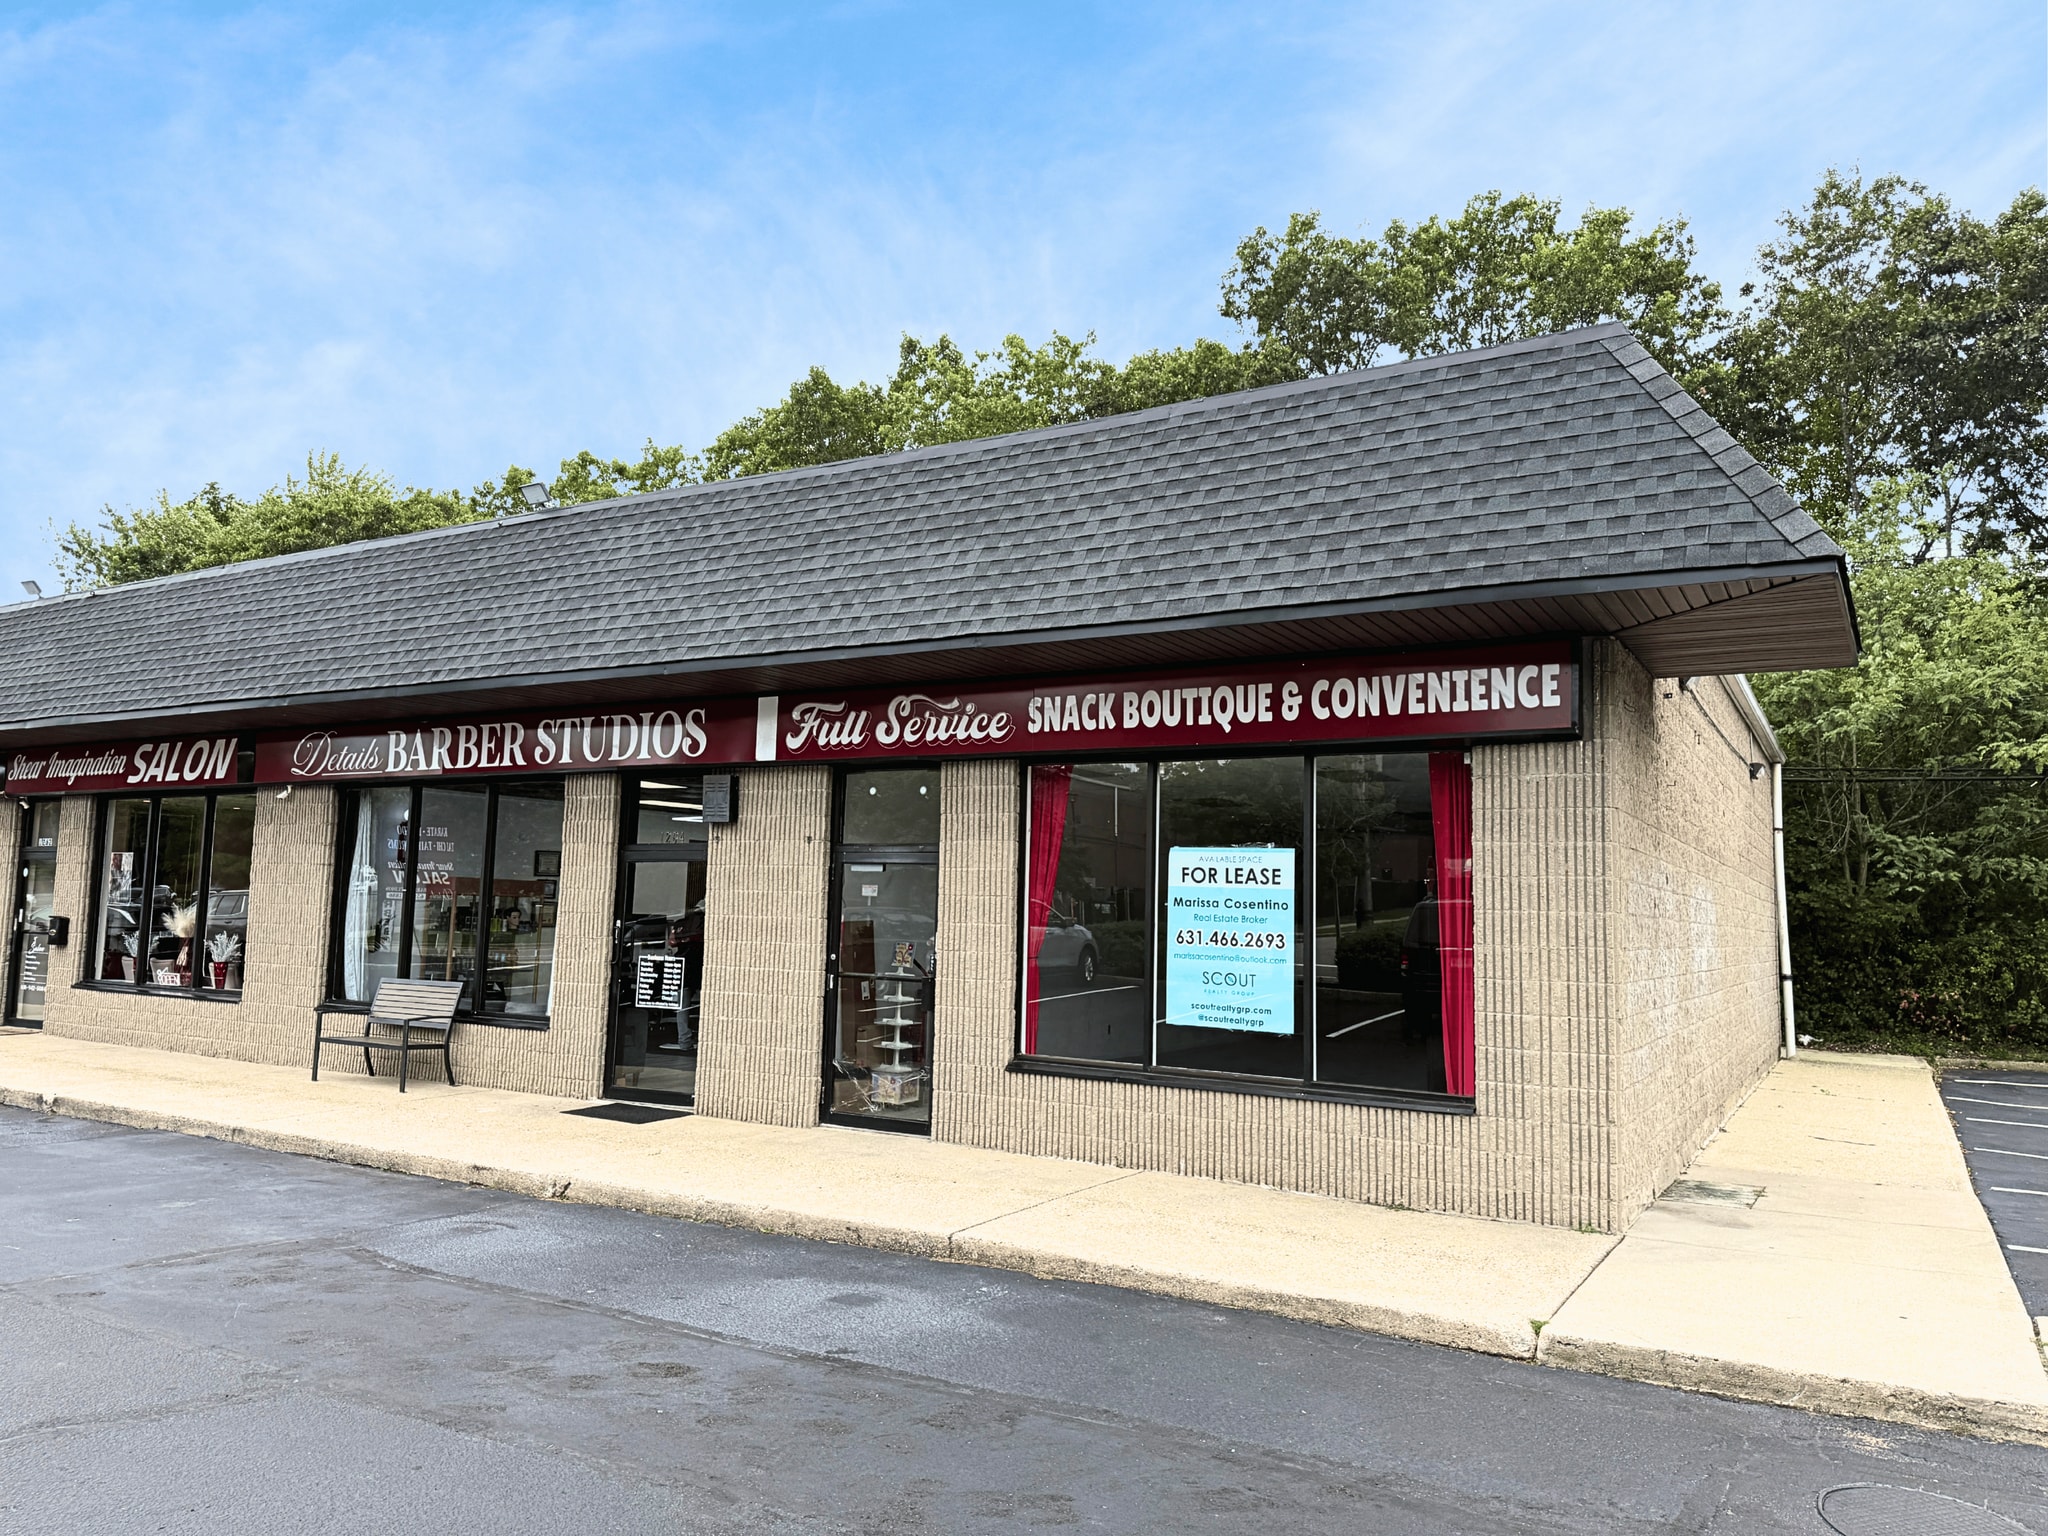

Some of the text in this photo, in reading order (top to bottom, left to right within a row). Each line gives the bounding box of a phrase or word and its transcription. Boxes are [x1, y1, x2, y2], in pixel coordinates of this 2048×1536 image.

[786, 664, 1560, 752] Full Service SNACK BOUTIQUE & CONVENIENCE
[291, 709, 708, 777] Details BARBER STUDIOS
[8, 738, 238, 786] Shear Imagination SALON
[1182, 867, 1282, 885] FOR LEASE
[1173, 897, 1289, 911] Marissa Cosentino
[1193, 914, 1268, 924] Real Estate Broker
[1176, 929, 1286, 949] 631.466.2693
[1202, 971, 1257, 987] SCOUT
[1191, 1003, 1272, 1015] scoutrealtygrp.com
[1198, 1014, 1264, 1027] @scoutrealtygrp
